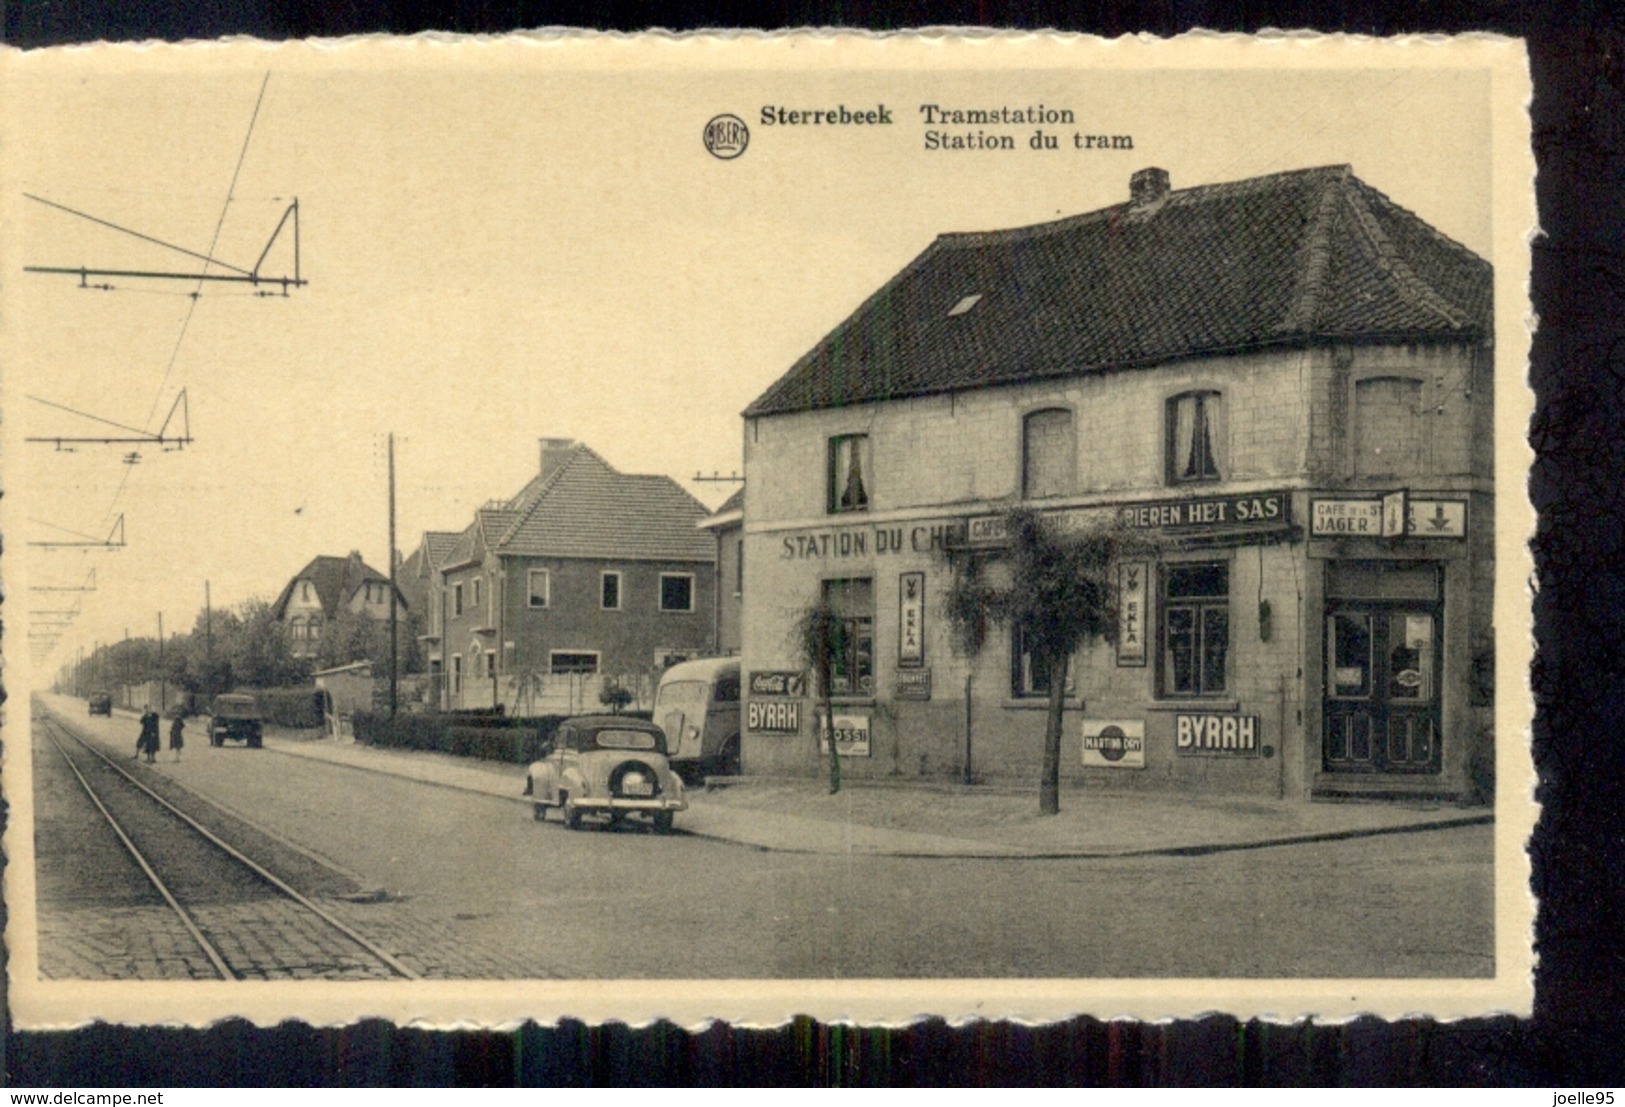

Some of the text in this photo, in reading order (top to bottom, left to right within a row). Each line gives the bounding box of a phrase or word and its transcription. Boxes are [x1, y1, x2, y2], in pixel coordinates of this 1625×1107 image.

[1188, 502, 1227, 523] HET
[1236, 498, 1278, 520] SAS
[1318, 504, 1345, 516] CAFE
[1316, 517, 1368, 532] JAGER
[781, 531, 866, 560] STATION
[876, 528, 903, 556] DU
[749, 703, 798, 729] BYRRH
[1124, 737, 1141, 750] DRY
[1177, 716, 1254, 749] BYRRH
